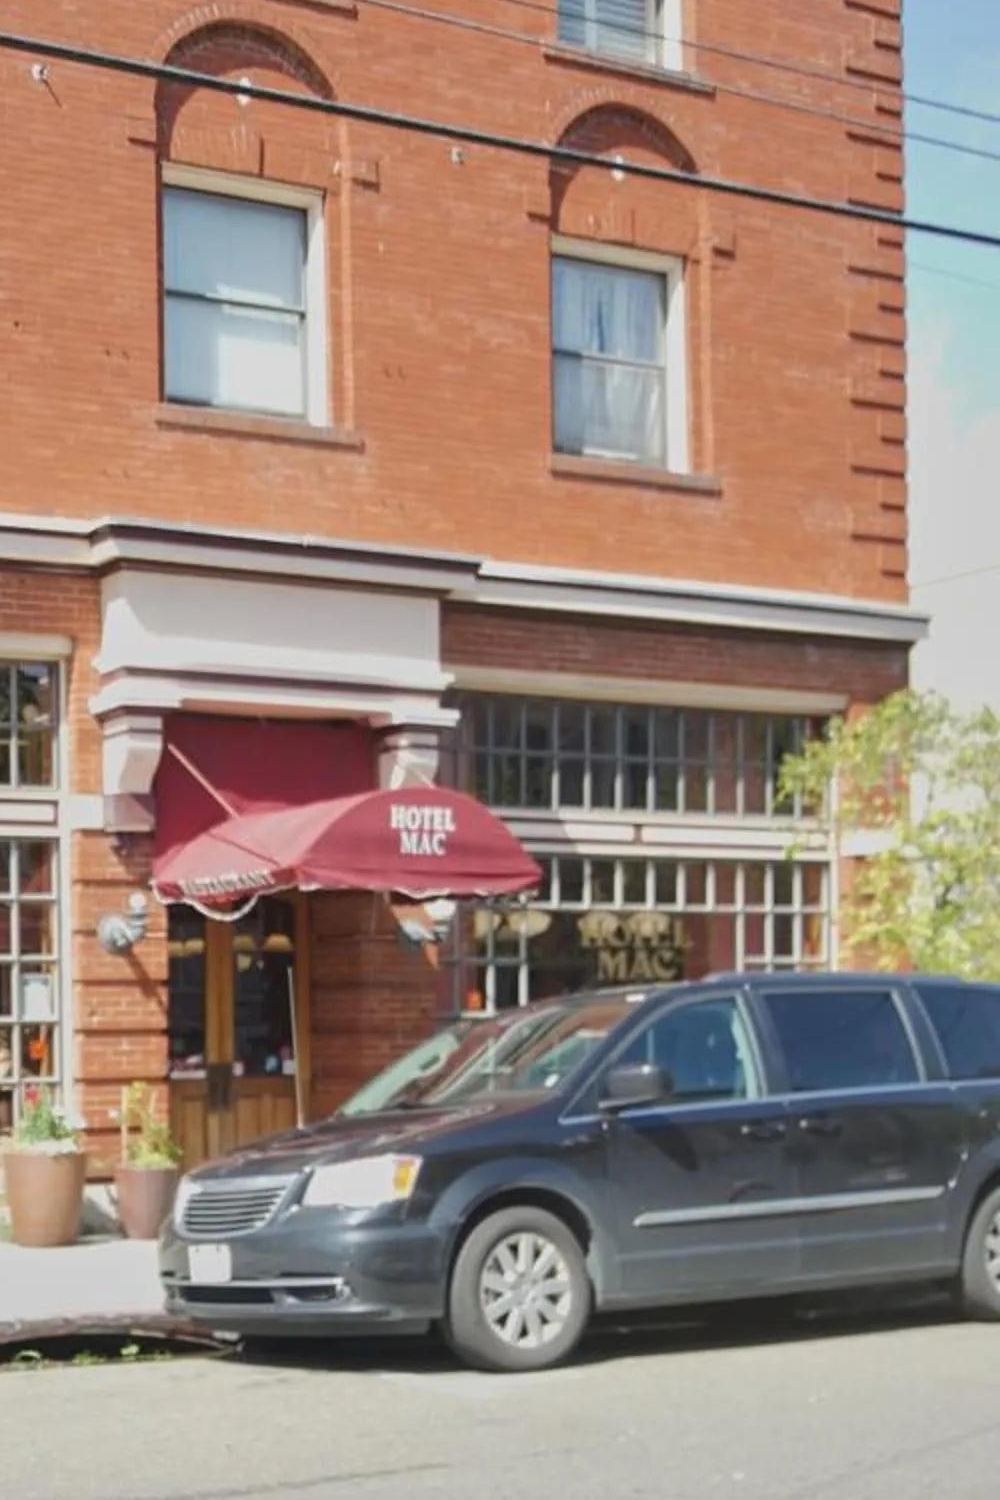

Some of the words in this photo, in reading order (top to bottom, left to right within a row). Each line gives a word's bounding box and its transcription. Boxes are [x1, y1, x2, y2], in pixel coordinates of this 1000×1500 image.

[389, 804, 456, 831] HOTEL
[400, 830, 447, 856] MAC
[581, 914, 692, 948] HOTEL
[597, 948, 677, 981] MAC
